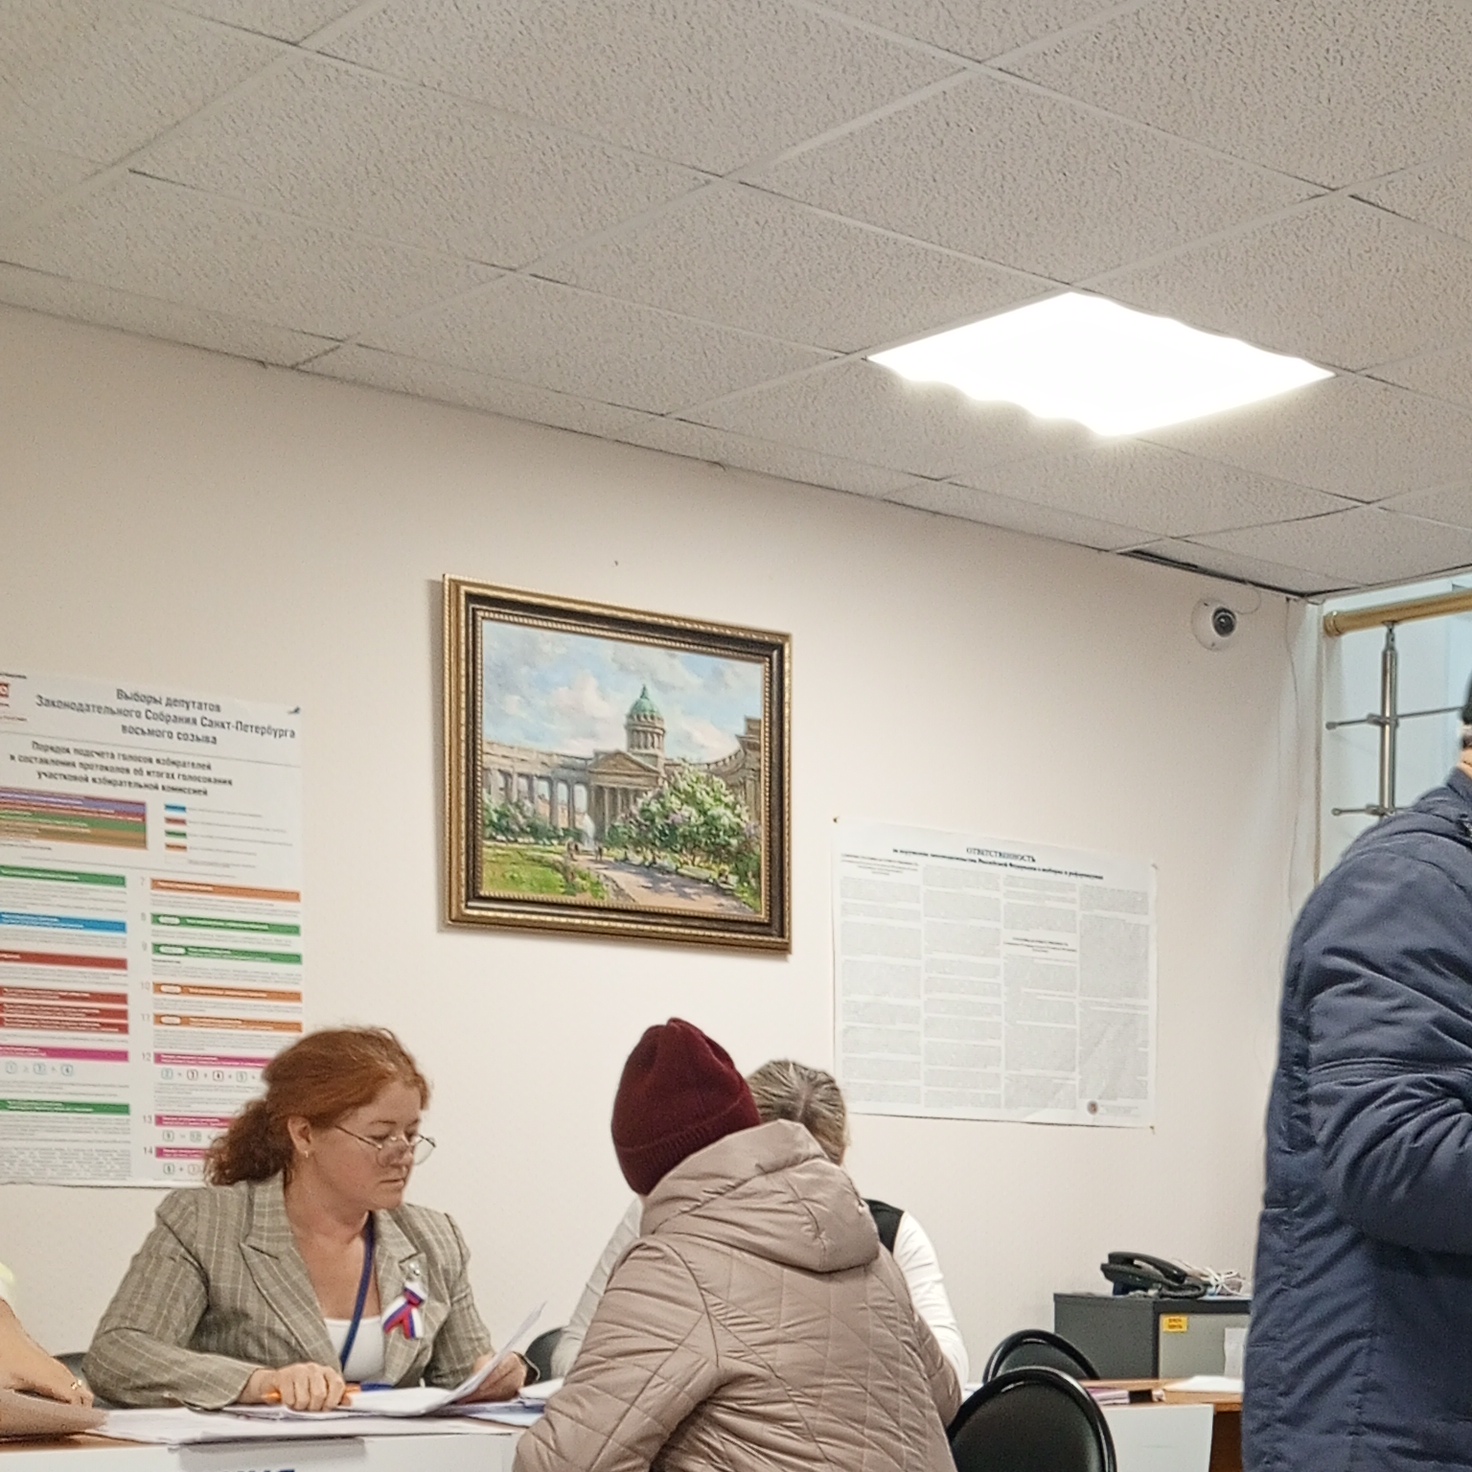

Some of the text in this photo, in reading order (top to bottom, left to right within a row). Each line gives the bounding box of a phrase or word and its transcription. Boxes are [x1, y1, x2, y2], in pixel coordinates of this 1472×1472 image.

[116, 688, 221, 713] Выборы депутатов
[36, 694, 296, 739] Законодательного Собрания Санкт-Петербурга
[121, 724, 217, 745] восьмого созыва
